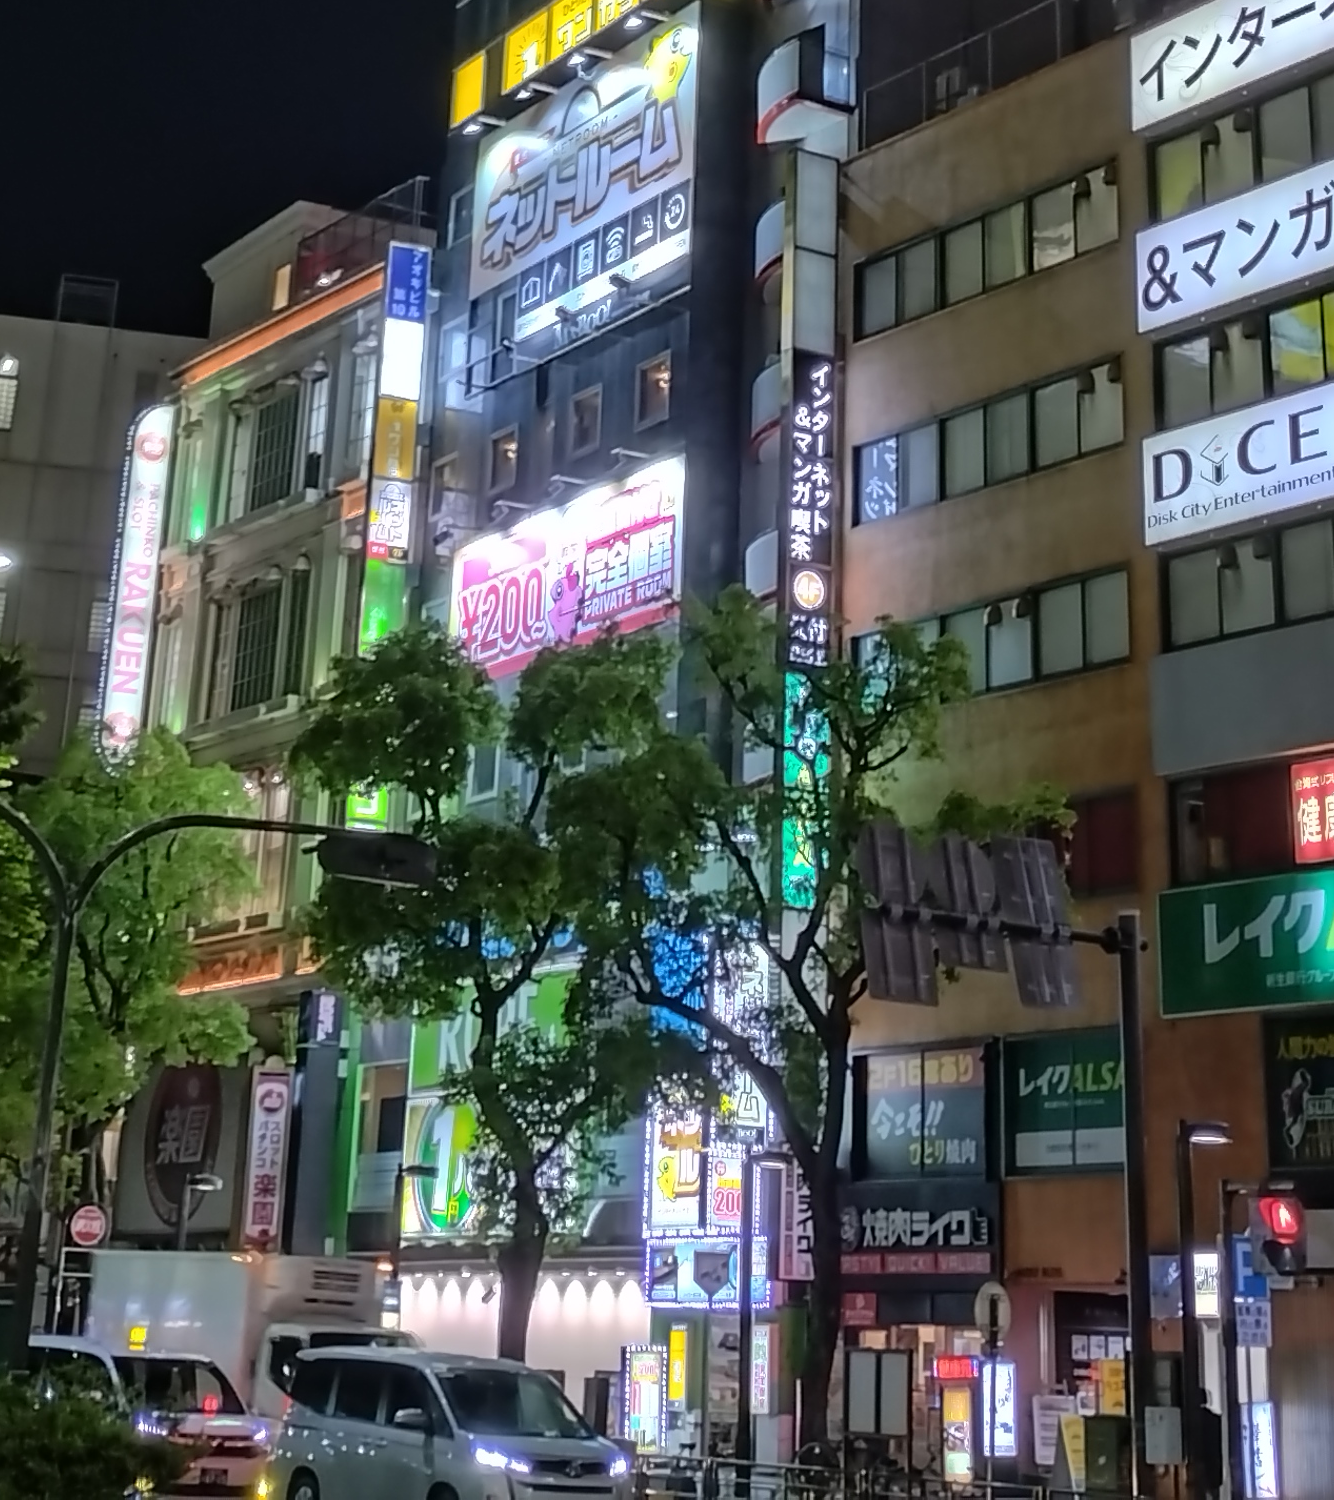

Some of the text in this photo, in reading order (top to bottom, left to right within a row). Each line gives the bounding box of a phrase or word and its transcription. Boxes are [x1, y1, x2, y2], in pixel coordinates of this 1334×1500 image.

[811, 362, 832, 536] インターネット
[789, 405, 813, 562] &マンガ喫茶
[130, 497, 145, 530] SLOT
[142, 483, 161, 558] PACHINKO
[1146, 507, 1179, 531] Disk
[1180, 499, 1211, 526] City
[111, 561, 152, 695] RAKUEN
[583, 584, 633, 620] PRIVATE
[861, 1205, 971, 1248] 焼肉ライク
